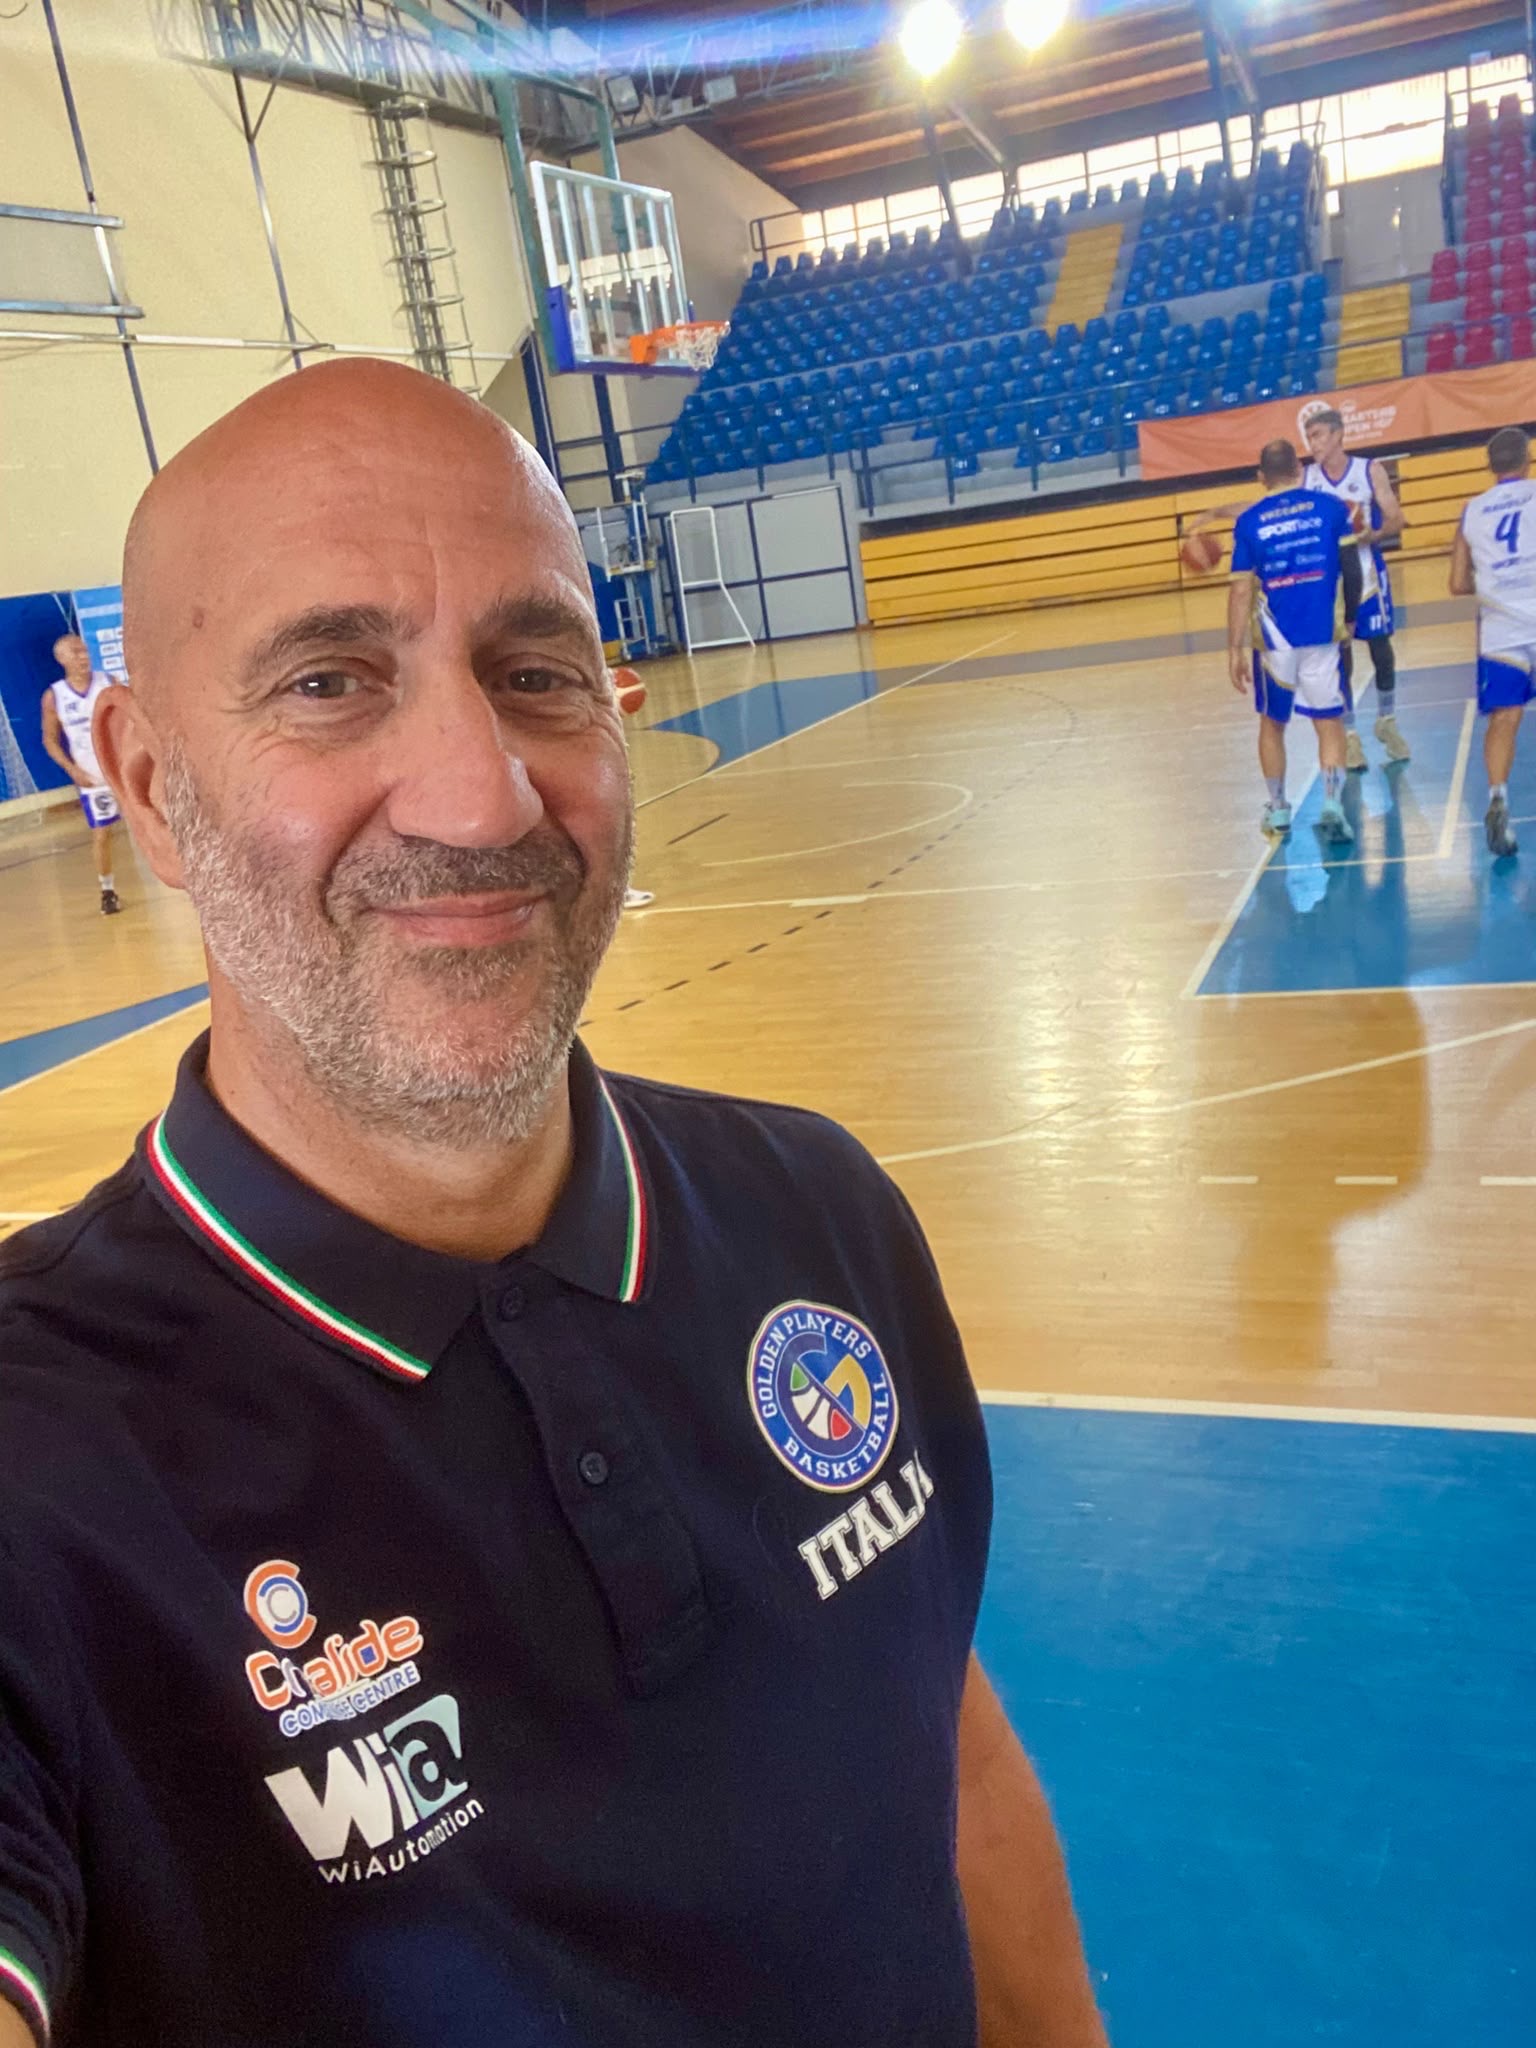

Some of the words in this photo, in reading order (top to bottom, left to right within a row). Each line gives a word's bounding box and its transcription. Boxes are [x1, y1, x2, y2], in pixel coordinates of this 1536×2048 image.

[1495, 511, 1522, 553] 4
[757, 1327, 787, 1418] GOLDEN
[782, 1312, 872, 1360] PLAYERS
[783, 1372, 890, 1480] BASKETBALL
[351, 1660, 421, 1714] CENTRE
[264, 1695, 468, 1862] Wia
[318, 1798, 485, 1885] WiAutomation
